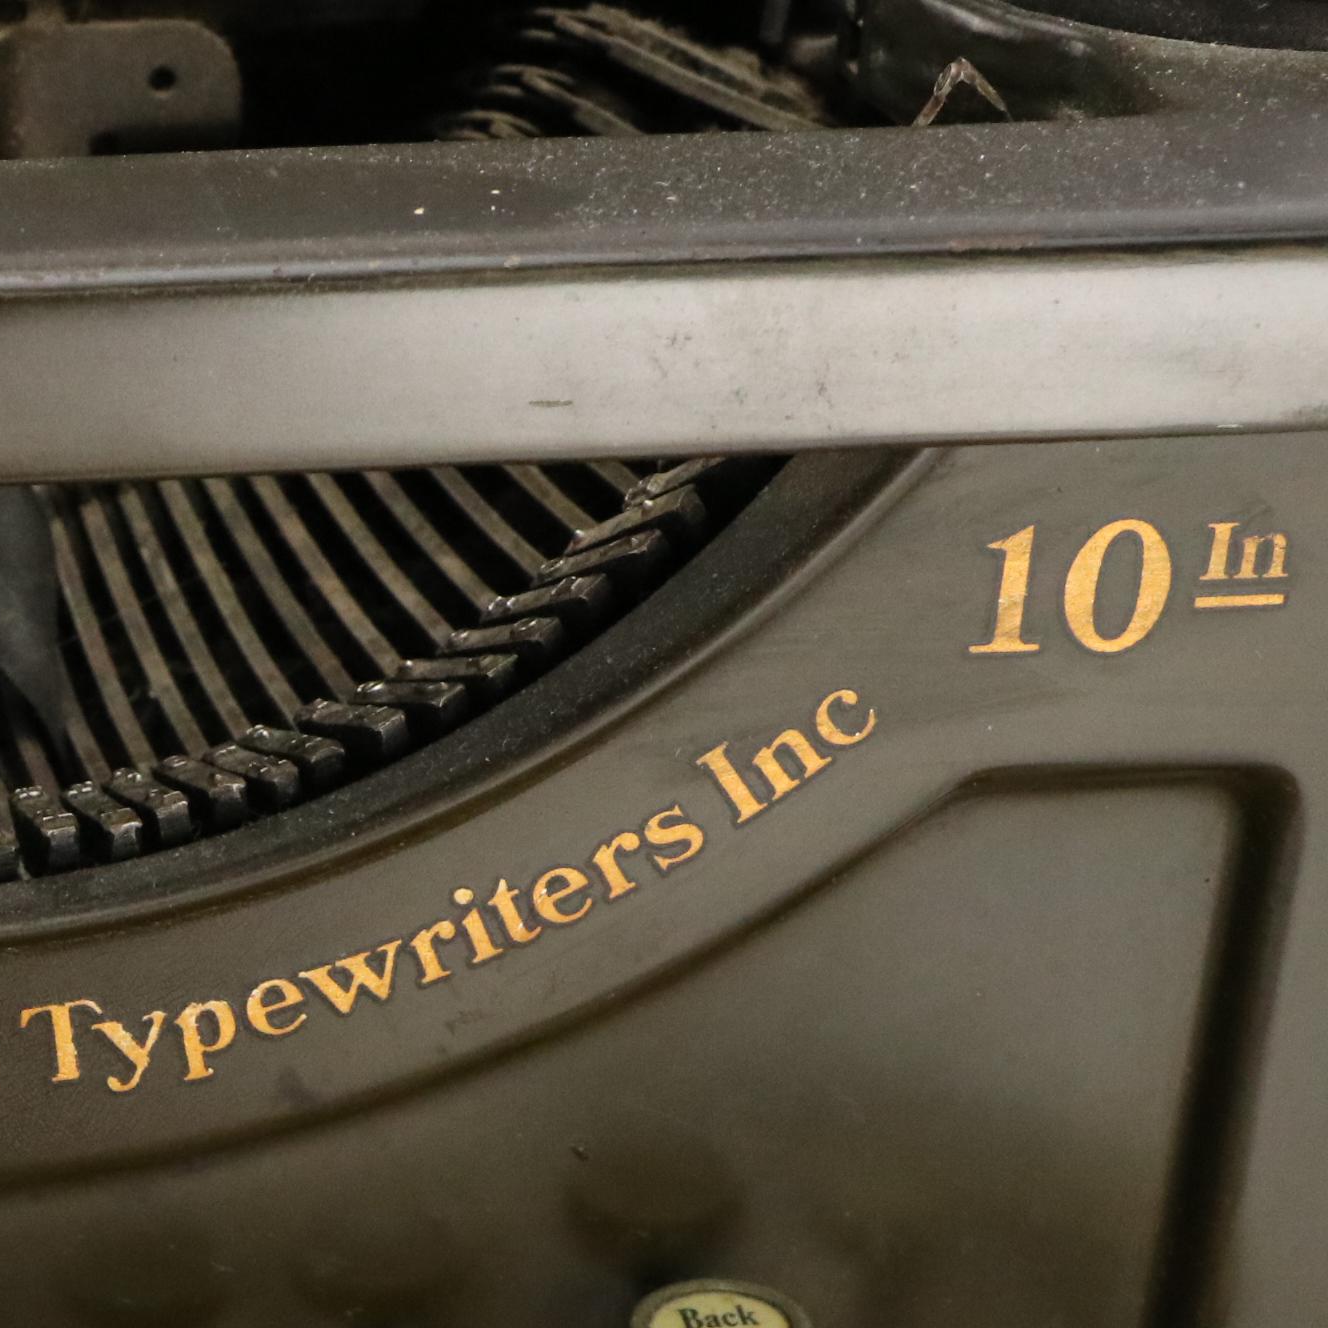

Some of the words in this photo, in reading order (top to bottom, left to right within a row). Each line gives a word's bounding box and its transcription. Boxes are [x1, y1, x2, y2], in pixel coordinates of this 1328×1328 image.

[971, 519, 1172, 652] 10
[1200, 522, 1287, 579] In
[20, 807, 704, 1091] Typewriters
[700, 690, 876, 821] Inc
